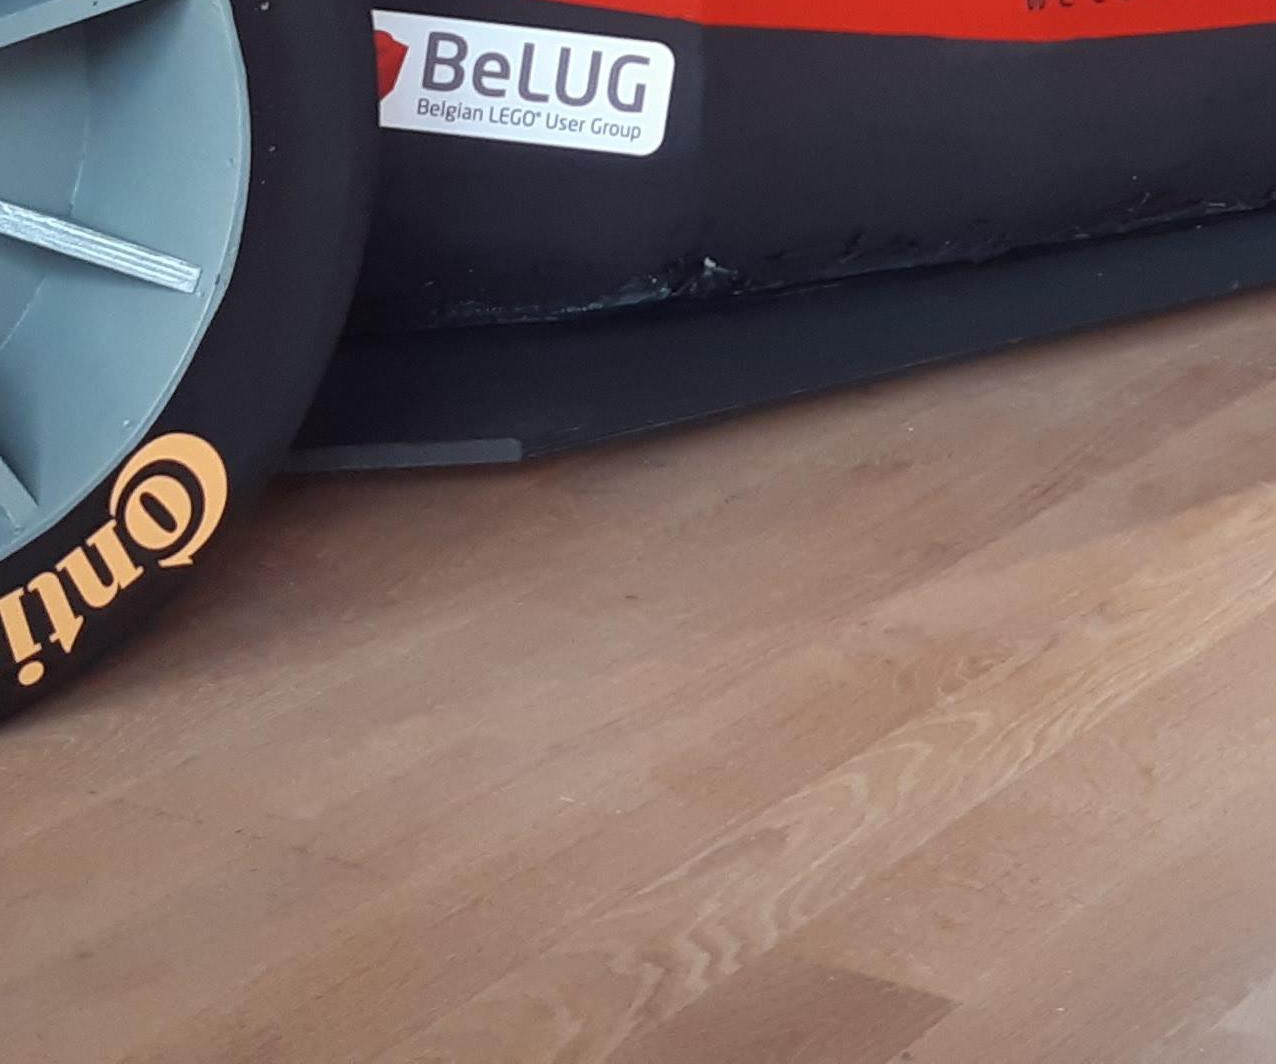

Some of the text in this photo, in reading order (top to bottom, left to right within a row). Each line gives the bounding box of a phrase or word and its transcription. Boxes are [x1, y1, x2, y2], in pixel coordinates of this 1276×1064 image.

[421, 31, 651, 113] BeLUG
[416, 97, 484, 122] Belgian
[545, 111, 586, 133] User
[590, 117, 642, 142] Group
